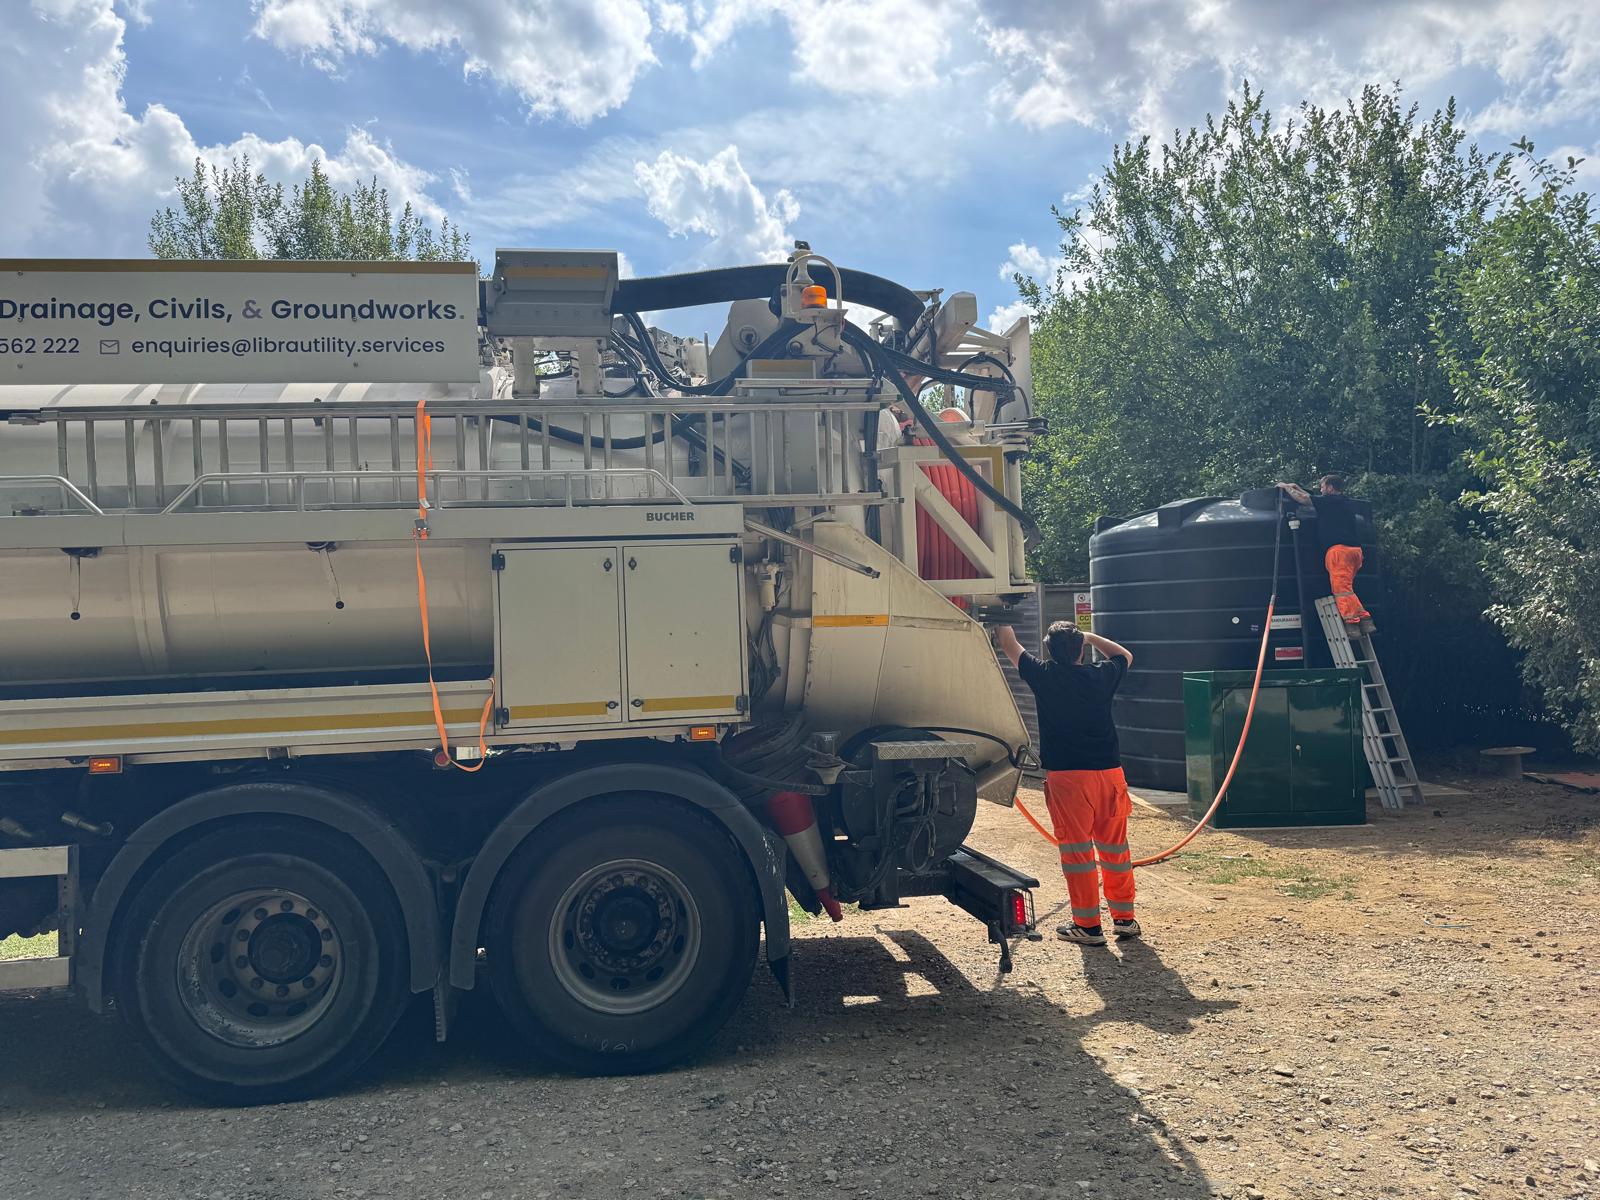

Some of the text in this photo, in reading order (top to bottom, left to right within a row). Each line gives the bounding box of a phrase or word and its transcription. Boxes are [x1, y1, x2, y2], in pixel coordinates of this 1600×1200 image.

[0, 297, 465, 327] Drainage, Civils, & Groundworks.
[0, 337, 445, 358] 562 222 enquiries@librautility.services
[646, 511, 695, 521] BUCHER
